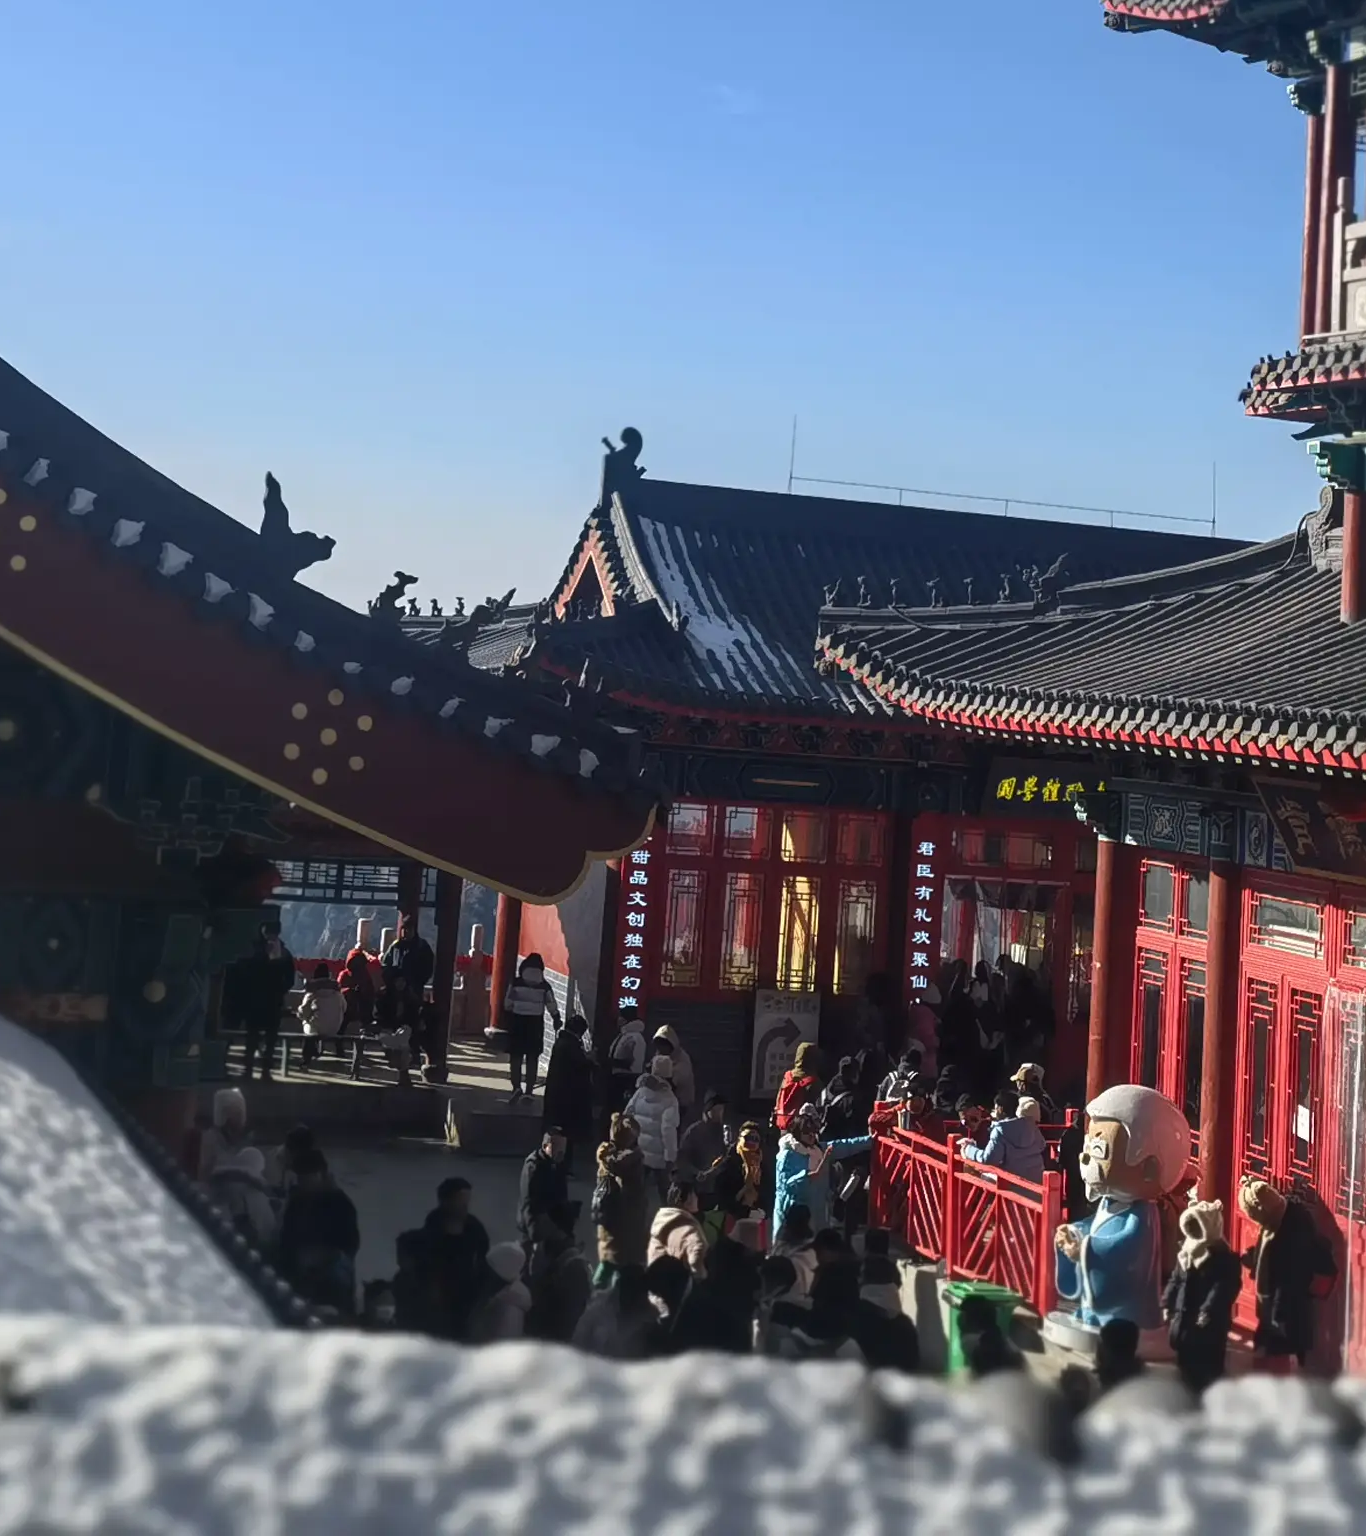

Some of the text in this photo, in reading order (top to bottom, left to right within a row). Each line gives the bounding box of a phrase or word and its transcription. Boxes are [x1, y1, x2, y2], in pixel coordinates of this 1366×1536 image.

[909, 841, 936, 1004] 君臣有礼欢聚仙
